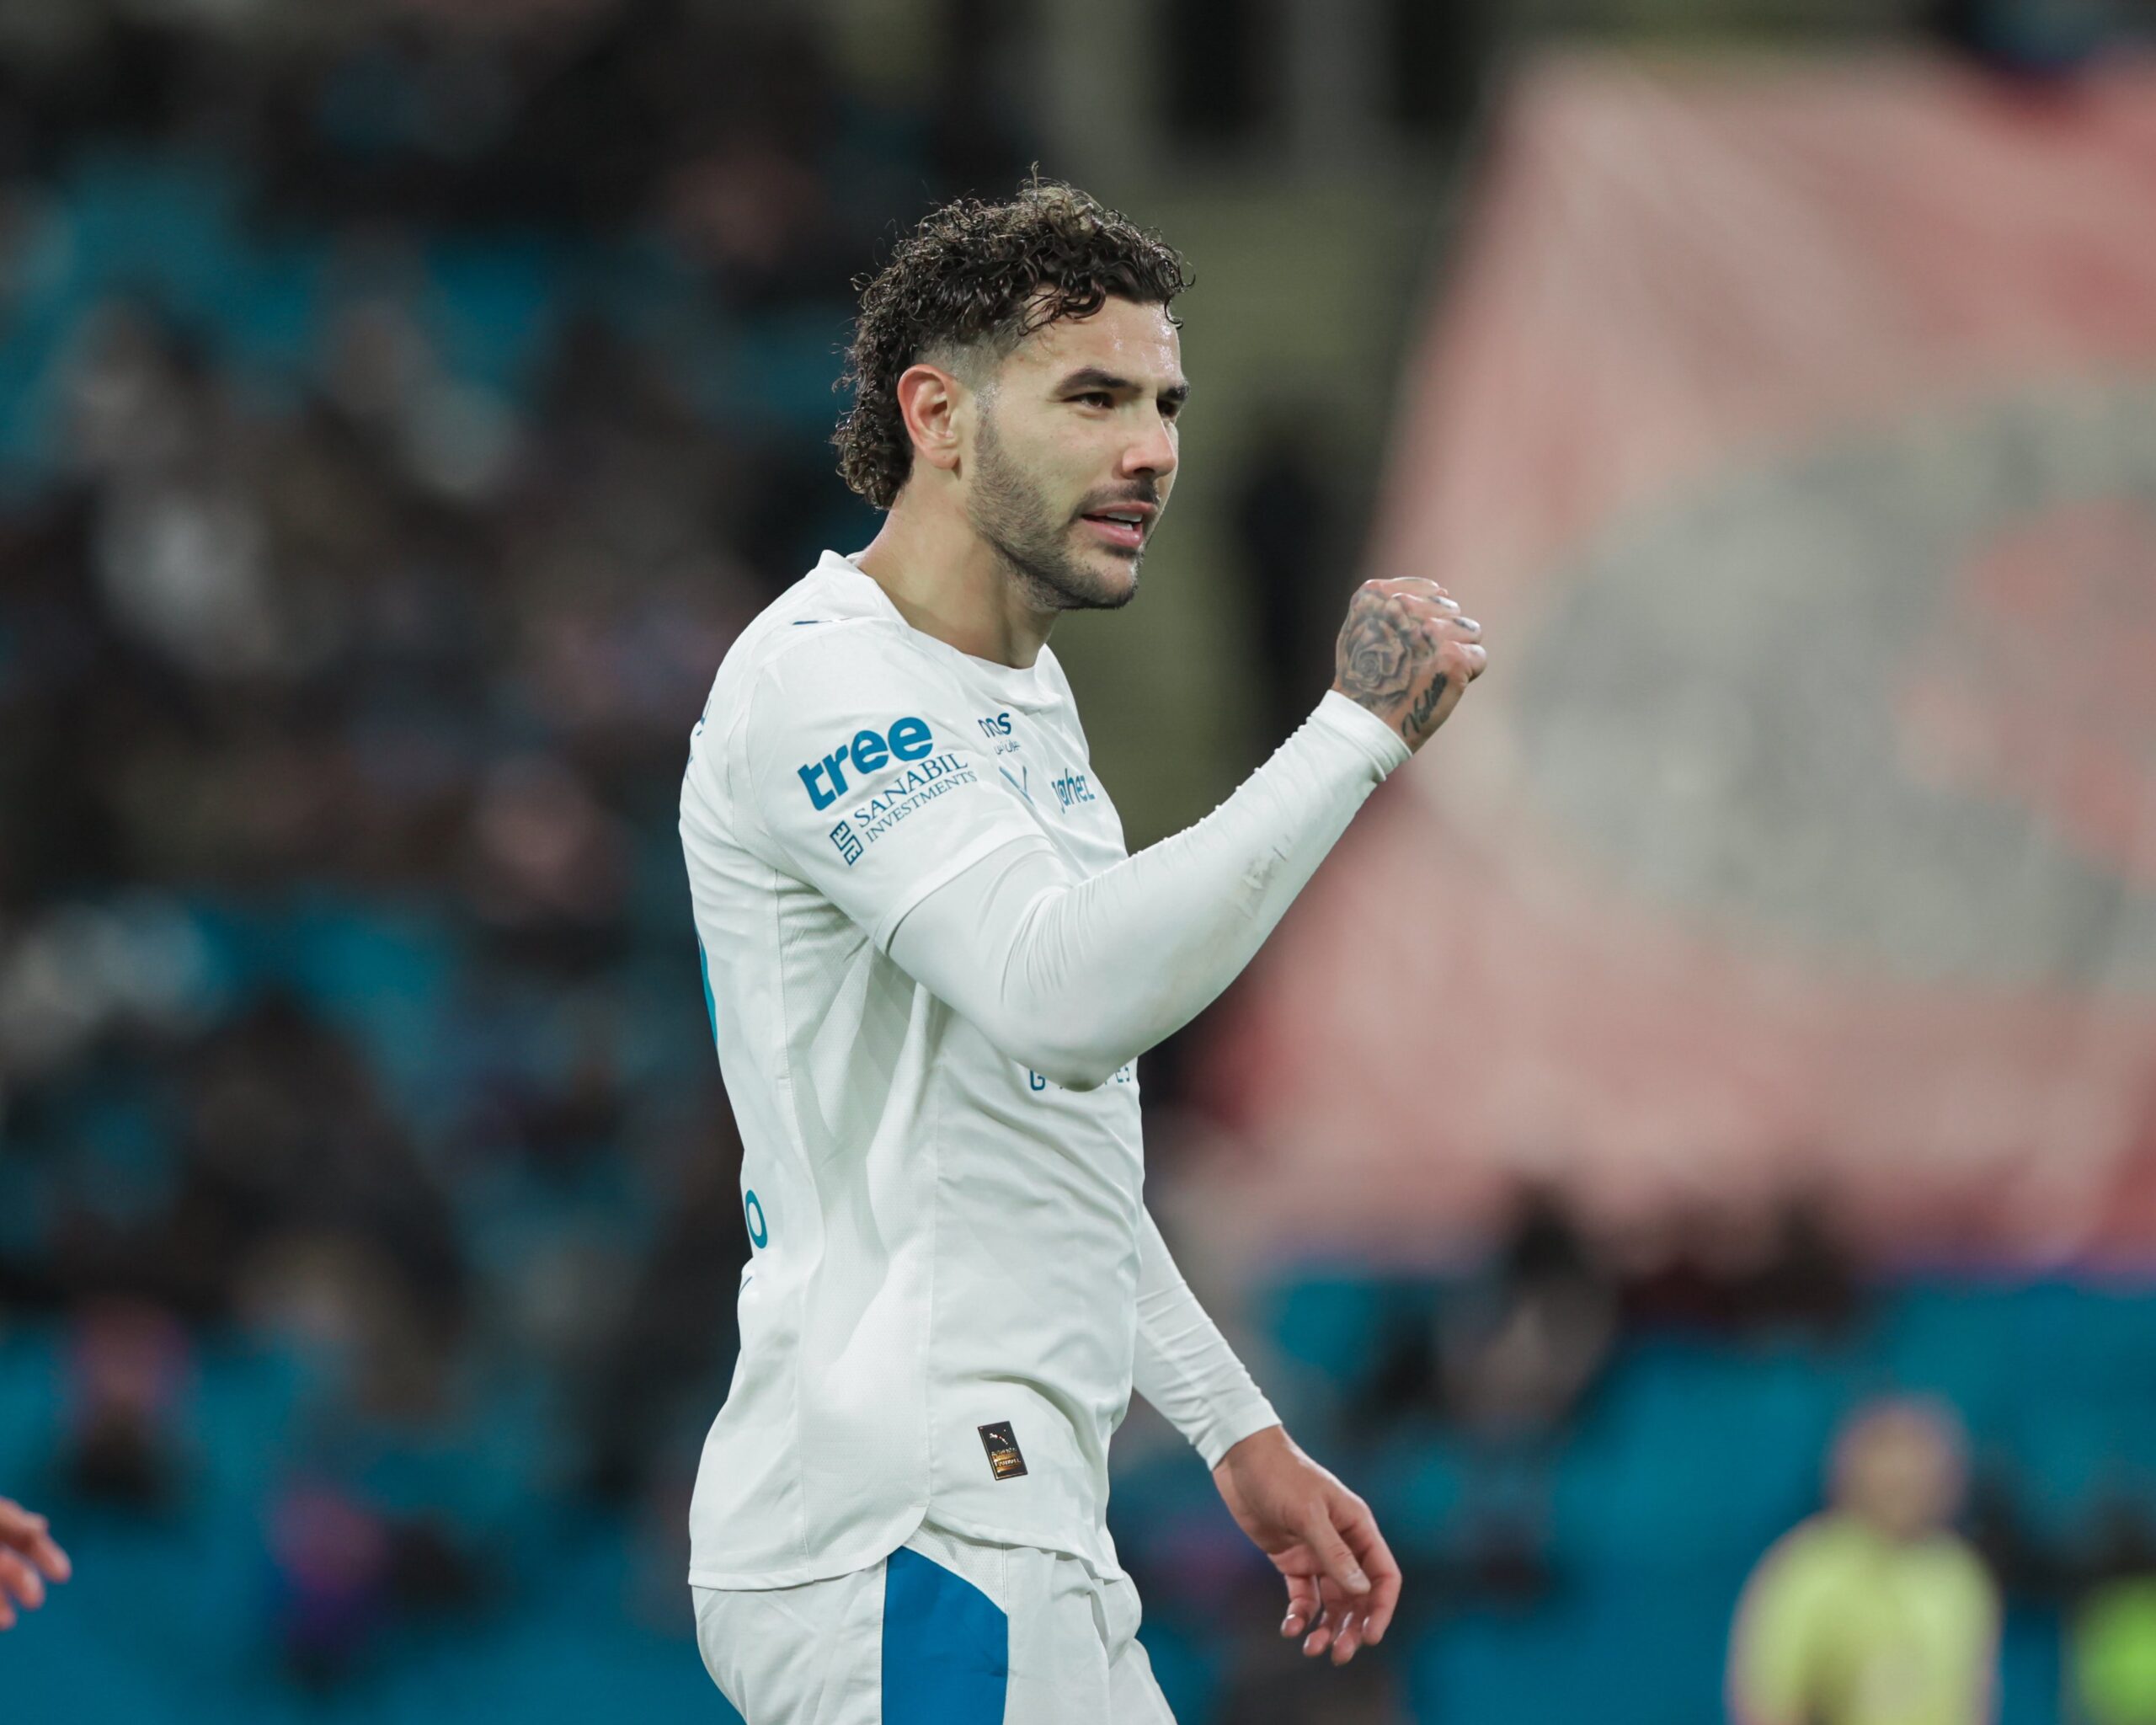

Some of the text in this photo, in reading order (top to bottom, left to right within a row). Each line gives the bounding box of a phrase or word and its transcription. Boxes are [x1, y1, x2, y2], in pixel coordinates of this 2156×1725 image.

[797, 716, 933, 811] tree
[854, 752, 969, 829] SANABIL
[1051, 768, 1096, 814] jahez
[864, 770, 978, 843] INVESTMENTS
